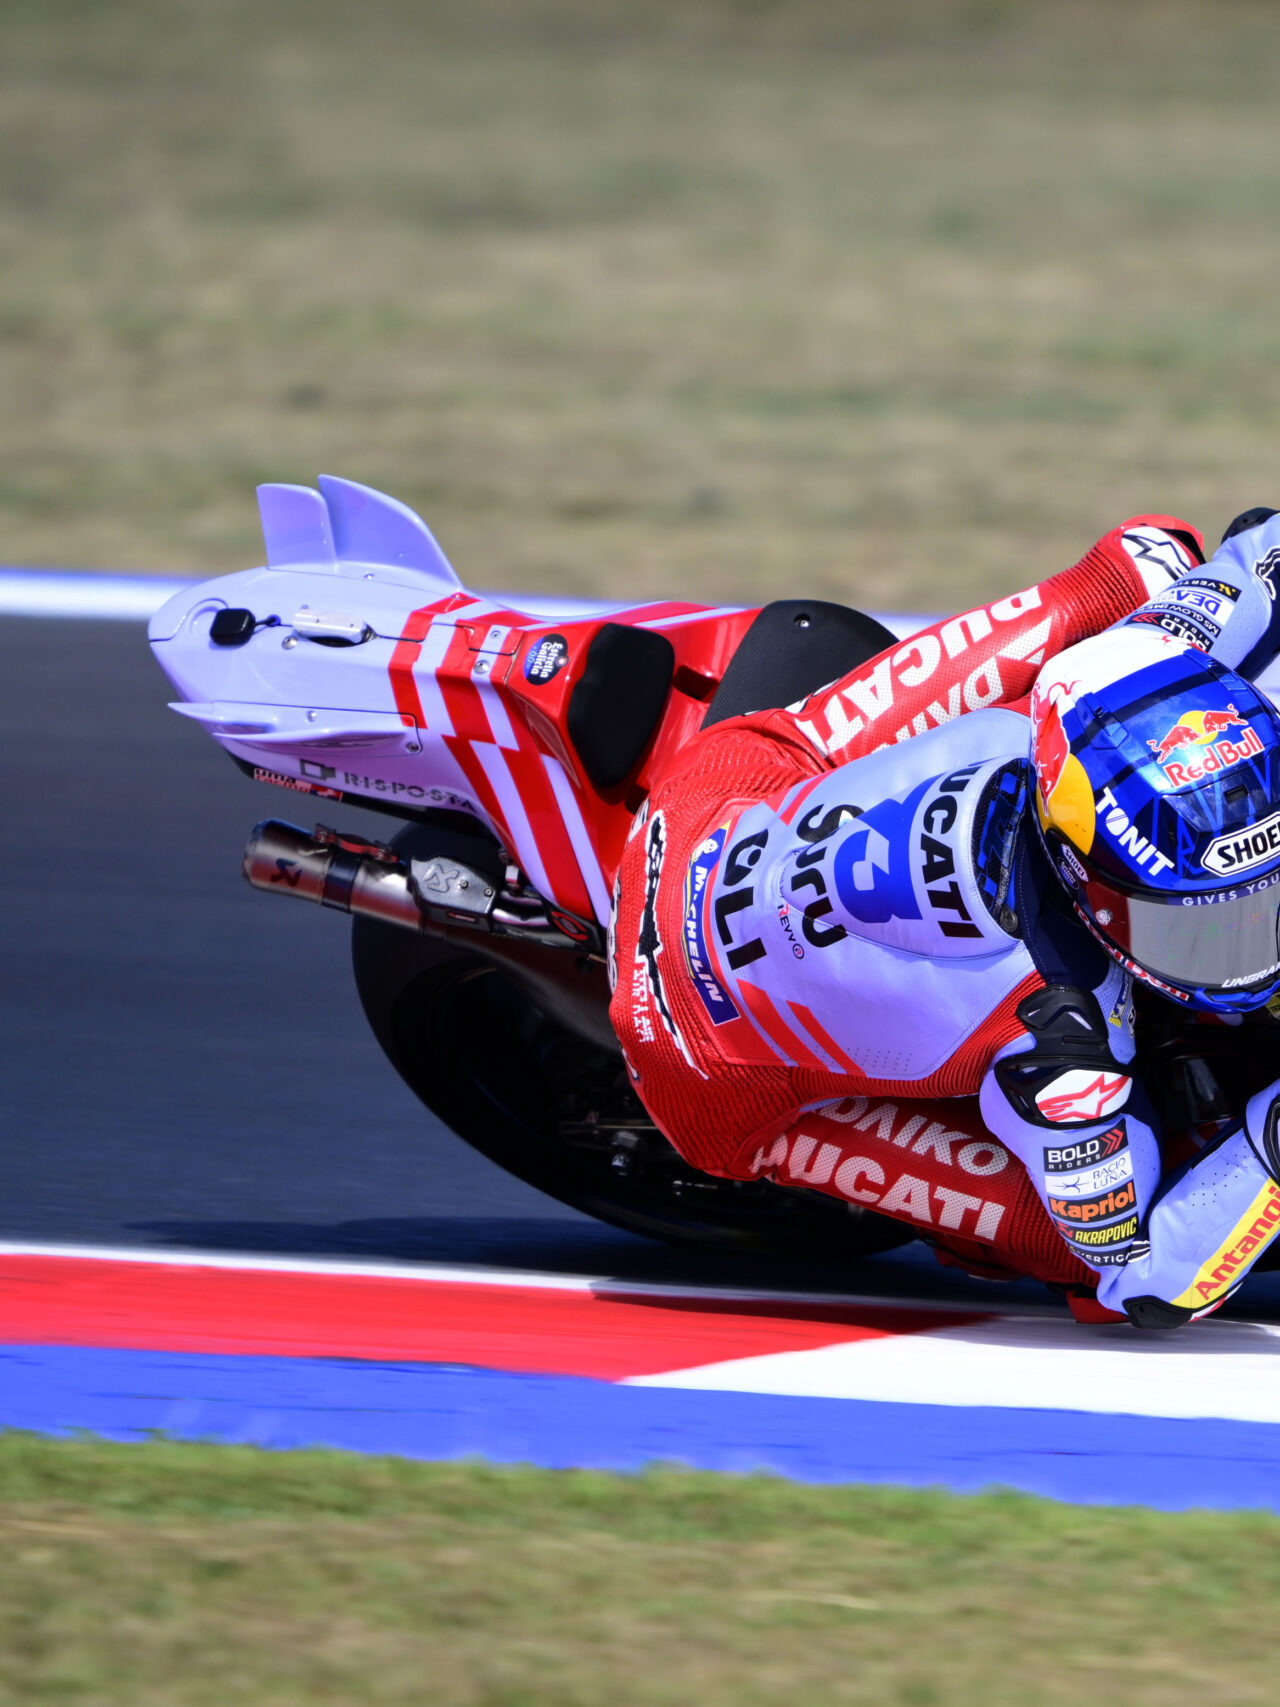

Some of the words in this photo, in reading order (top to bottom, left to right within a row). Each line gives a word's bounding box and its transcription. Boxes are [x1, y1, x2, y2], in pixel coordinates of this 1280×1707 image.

[795, 586, 1043, 757] DUCATI
[1163, 746, 1223, 788] Red
[1216, 727, 1265, 767] Bull
[920, 760, 986, 938] UCATI
[1095, 786, 1175, 876] TONIT
[1182, 891, 1237, 906] GIVES
[1246, 873, 1280, 895] YOU
[1048, 1139, 1100, 1163] BOLD
[1049, 1154, 1101, 1170] RIDERS
[1050, 1181, 1135, 1222] Kapriol
